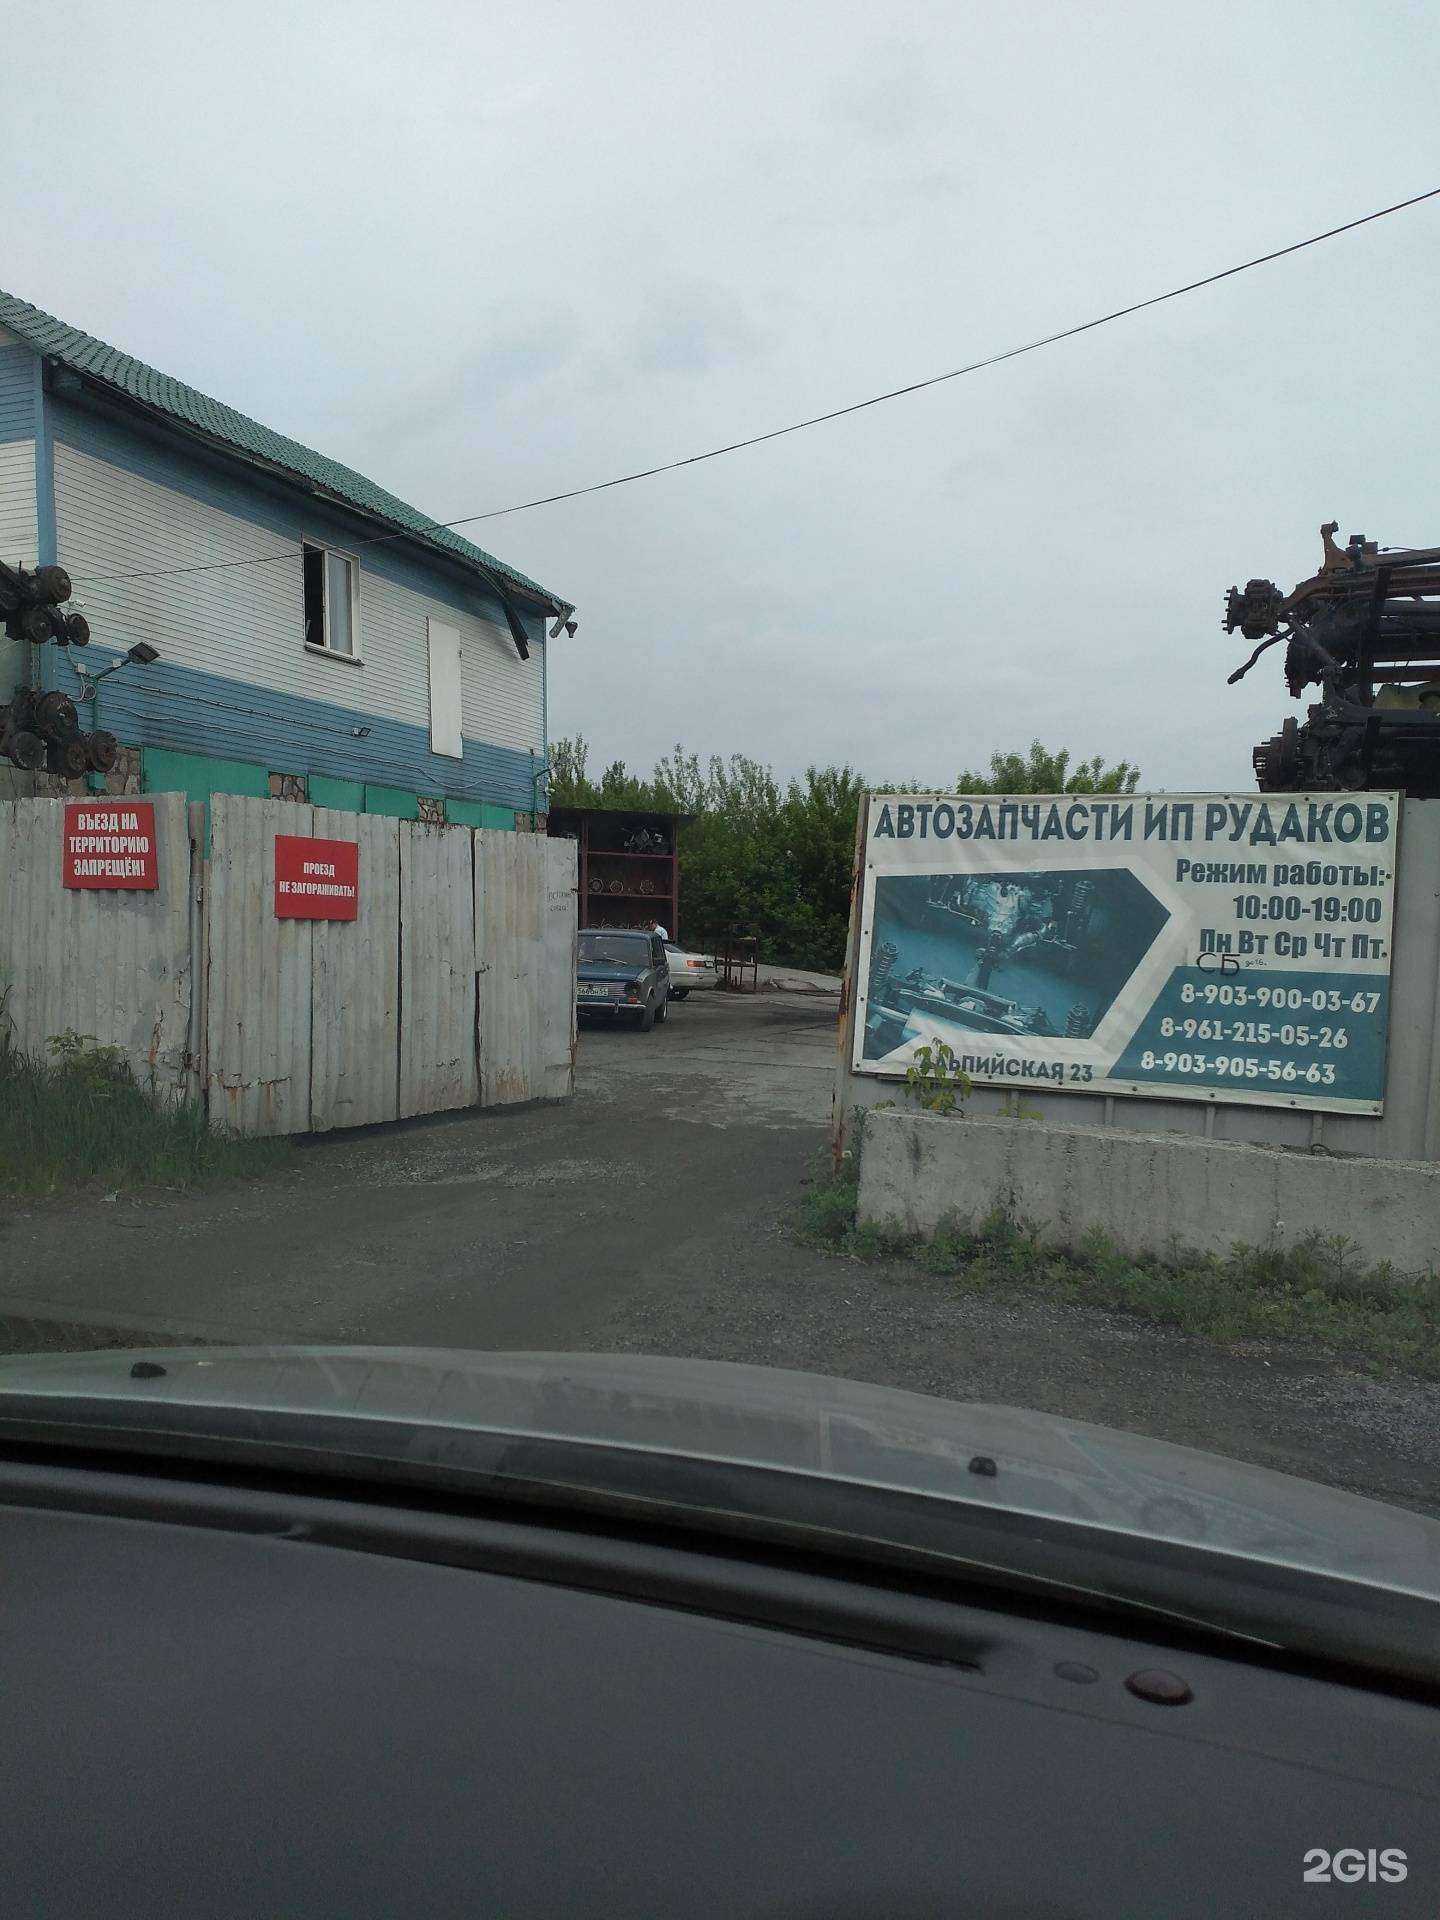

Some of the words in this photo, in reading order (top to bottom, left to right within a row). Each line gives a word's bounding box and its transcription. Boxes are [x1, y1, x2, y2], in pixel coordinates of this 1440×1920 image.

[78, 813, 118, 832] ВЪЕЗД
[121, 813, 139, 830] НА
[874, 803, 1134, 841] АВТОЗАПЧАСТИ
[1144, 803, 1194, 841] ИП
[1205, 803, 1390, 847] РУДАКОВ
[69, 836, 149, 853] ТЕРРИТОРИЮ
[74, 857, 146, 878] ЗАПРЕЩЁН!
[303, 862, 335, 878] ПРОЕЗД
[1176, 858, 1267, 884] Режим
[1273, 861, 1385, 887] работы:
[279, 880, 291, 893] НЕ
[291, 881, 355, 897] ЗАГОРАЖИВАТЬ!
[1233, 895, 1382, 923] 10:00-19:00
[1200, 928, 1232, 952] Пн
[1239, 930, 1268, 955] Вт
[1275, 931, 1307, 959] Ср
[1314, 933, 1346, 956] Чт
[1196, 952, 1241, 976] СБ
[1181, 983, 1381, 1013] 8-903-900-03-67
[1161, 1017, 1348, 1049] 8-961-215-05-26
[1070, 1063, 1093, 1082] 23
[1141, 1051, 1336, 1085] 8-903-905-56-63
